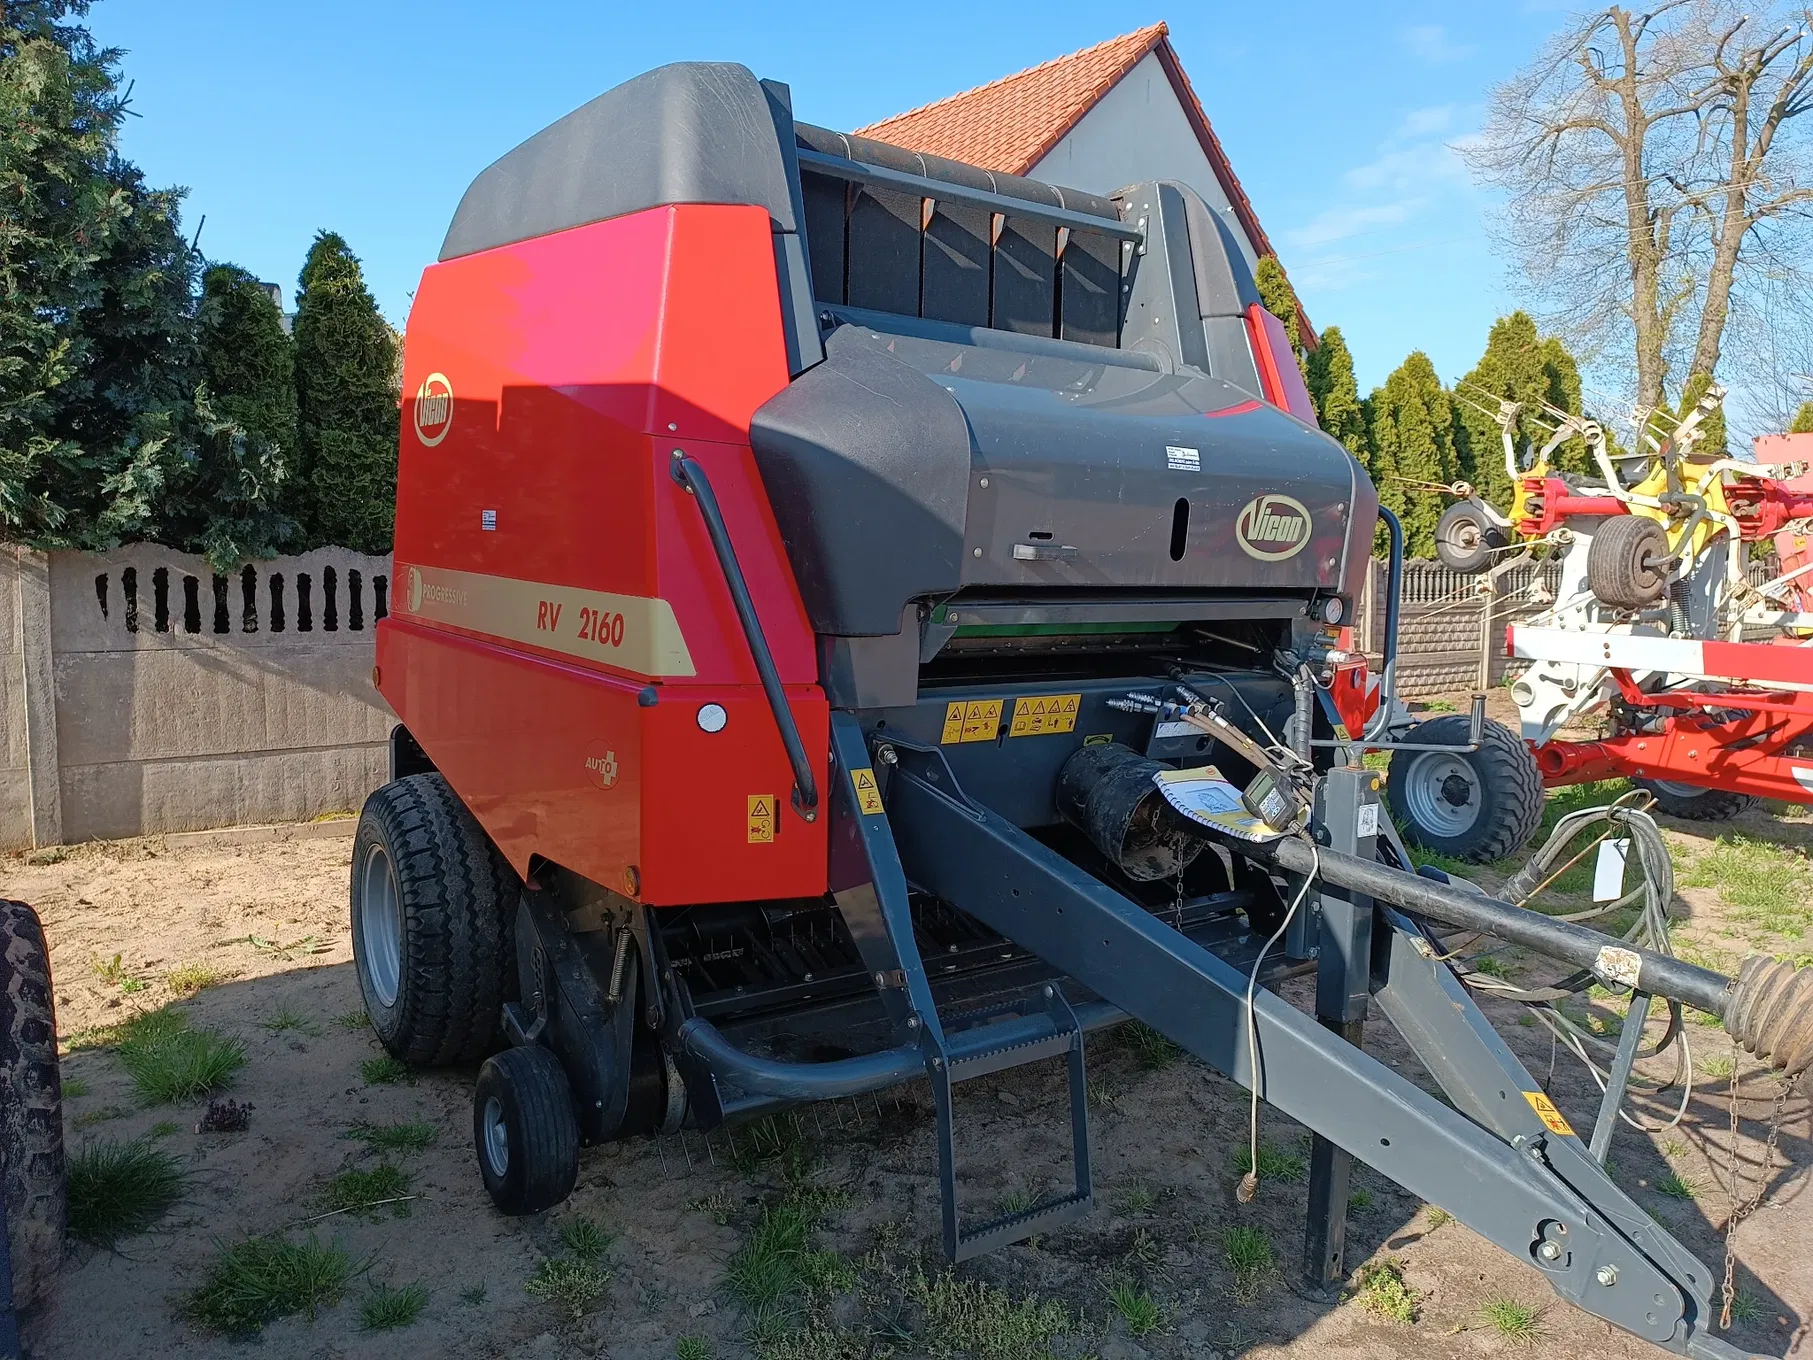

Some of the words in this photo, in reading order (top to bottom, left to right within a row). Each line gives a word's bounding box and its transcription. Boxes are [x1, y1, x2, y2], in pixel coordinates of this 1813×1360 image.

[1247, 499, 1304, 542] Vicon
[536, 600, 562, 632] RV
[577, 607, 625, 648] 2160
